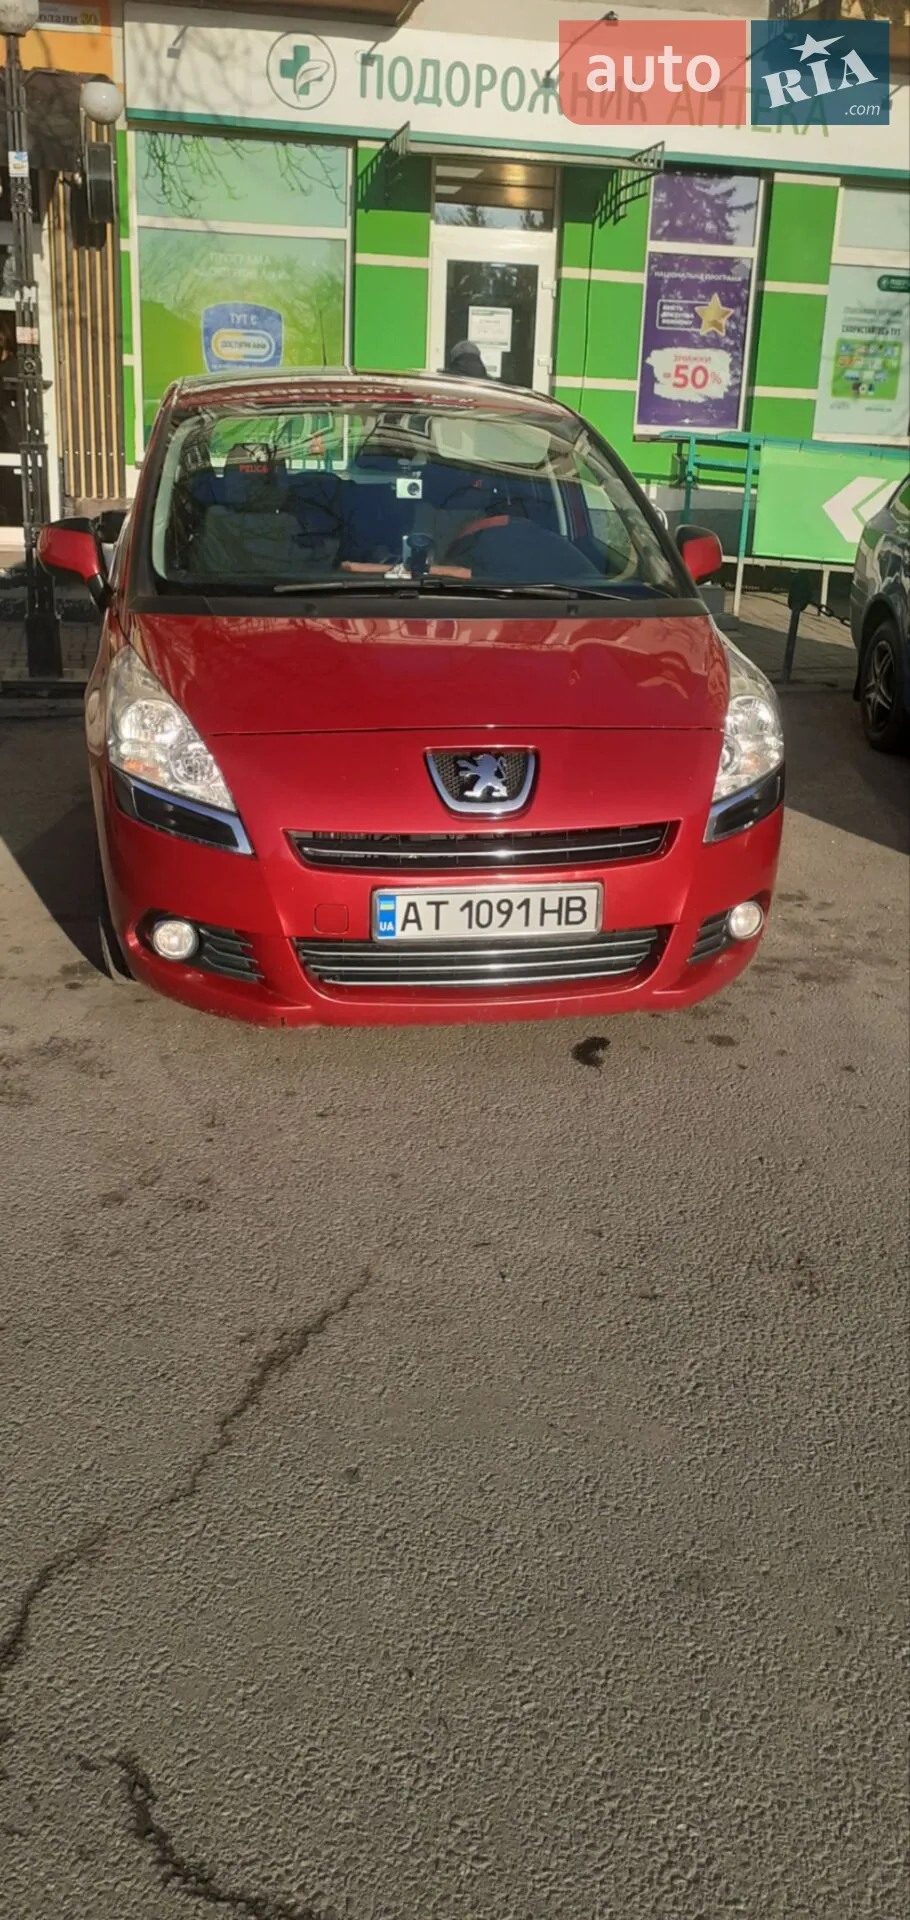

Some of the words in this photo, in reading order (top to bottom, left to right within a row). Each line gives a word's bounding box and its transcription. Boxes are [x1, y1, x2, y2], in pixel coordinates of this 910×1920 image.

[359, 53, 648, 122] ПОДОРОЖНИК
[379, 921, 394, 932] UA
[400, 900, 450, 932] AT
[459, 898, 531, 930] 1091
[539, 895, 588, 927] HB
